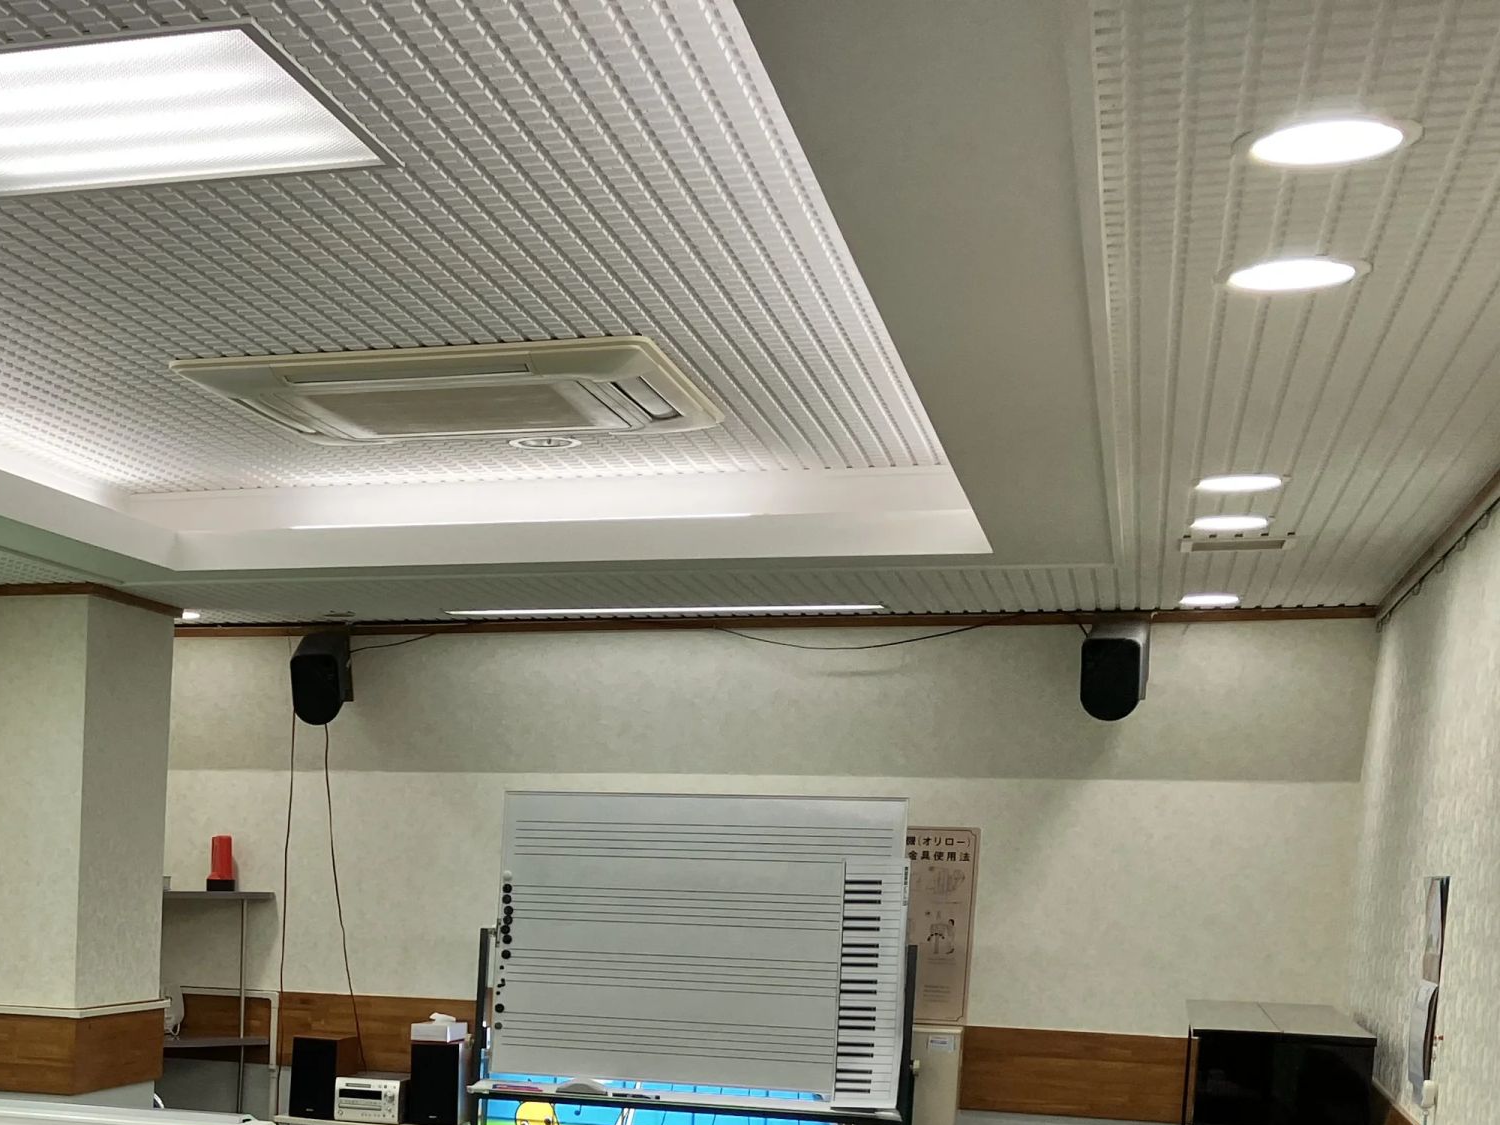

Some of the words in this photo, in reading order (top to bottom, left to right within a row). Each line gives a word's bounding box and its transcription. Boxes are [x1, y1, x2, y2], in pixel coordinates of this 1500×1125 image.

[908, 850, 970, 861] 金具使用法
